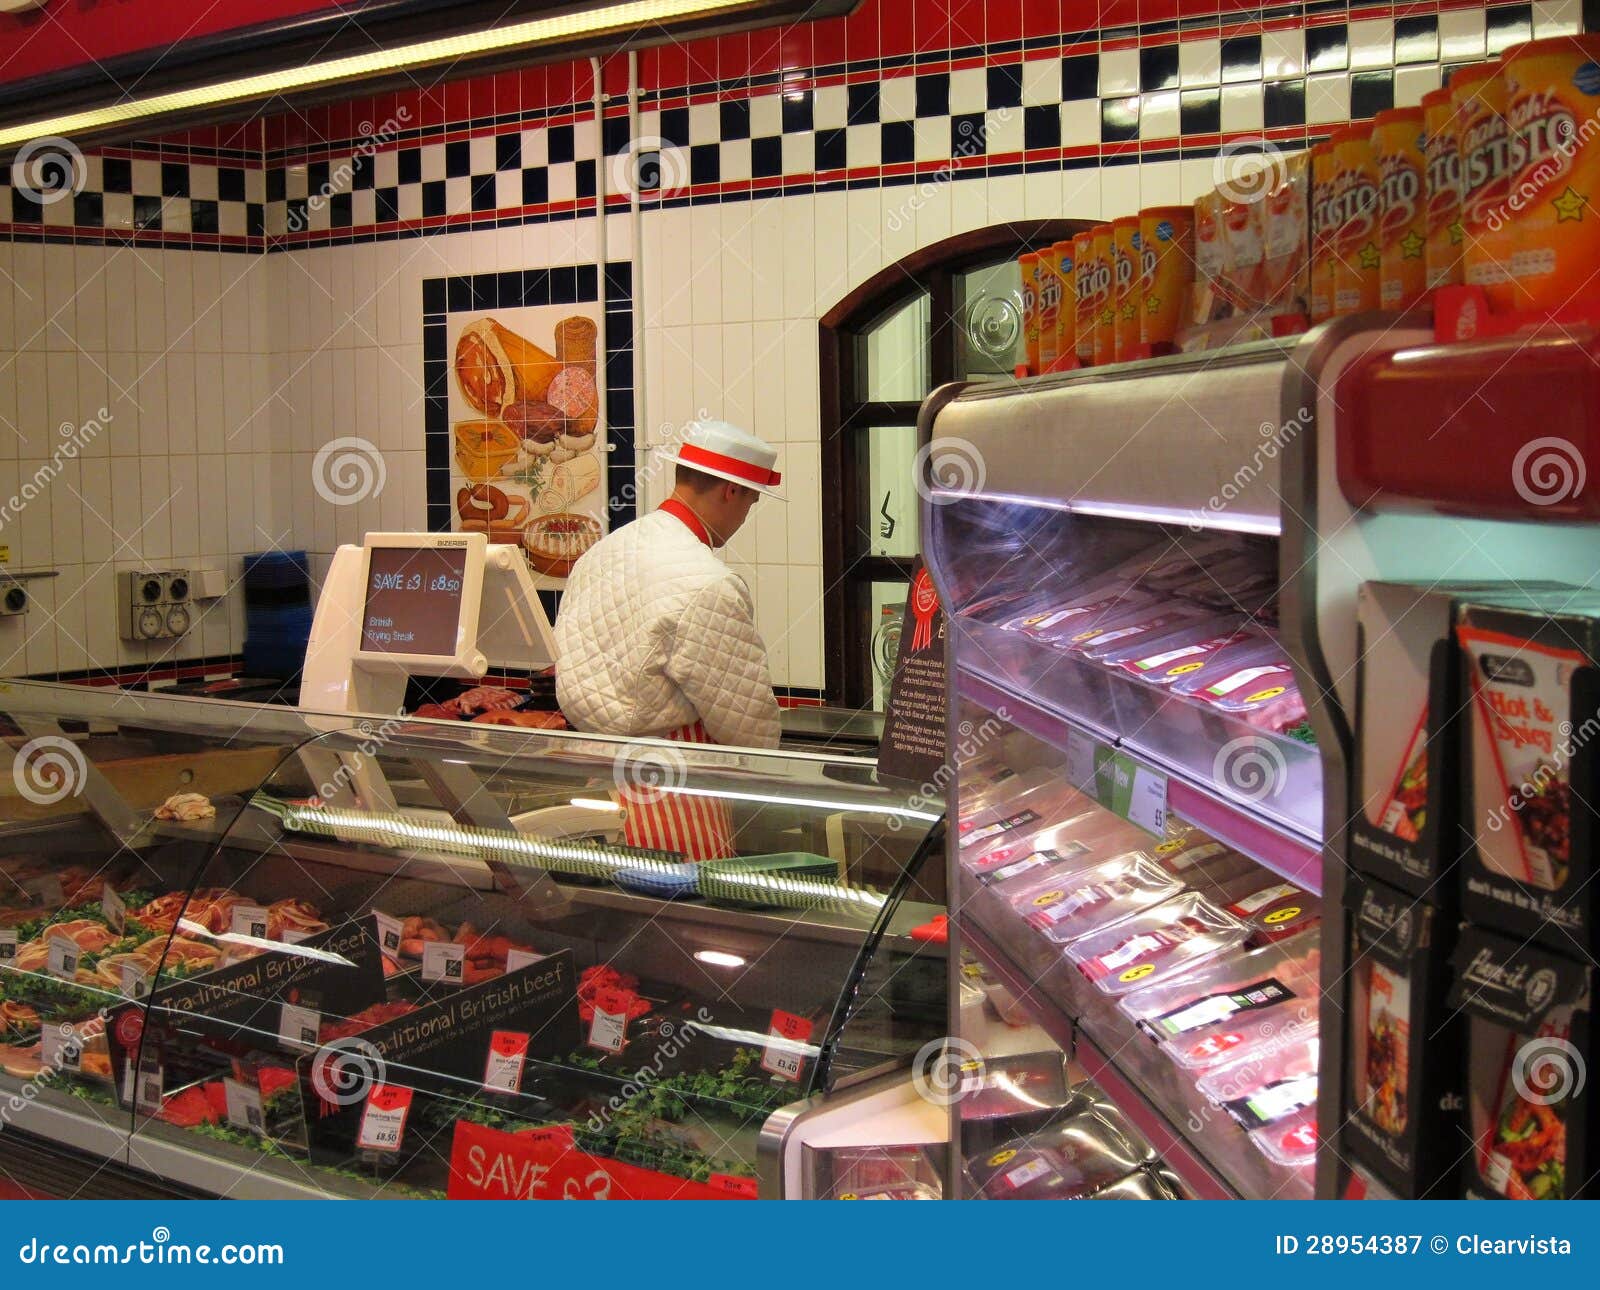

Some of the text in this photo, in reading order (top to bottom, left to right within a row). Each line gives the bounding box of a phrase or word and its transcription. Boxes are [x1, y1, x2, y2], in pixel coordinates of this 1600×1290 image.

[374, 573, 403, 590] SAVE
[406, 574, 421, 591] £3
[1489, 691, 1529, 719] Hot
[162, 965, 260, 1017] Traditional
[460, 978, 520, 1020] British
[523, 961, 564, 995] beef
[376, 1131, 397, 1142] £8.50
[466, 1145, 550, 1200] SAVE
